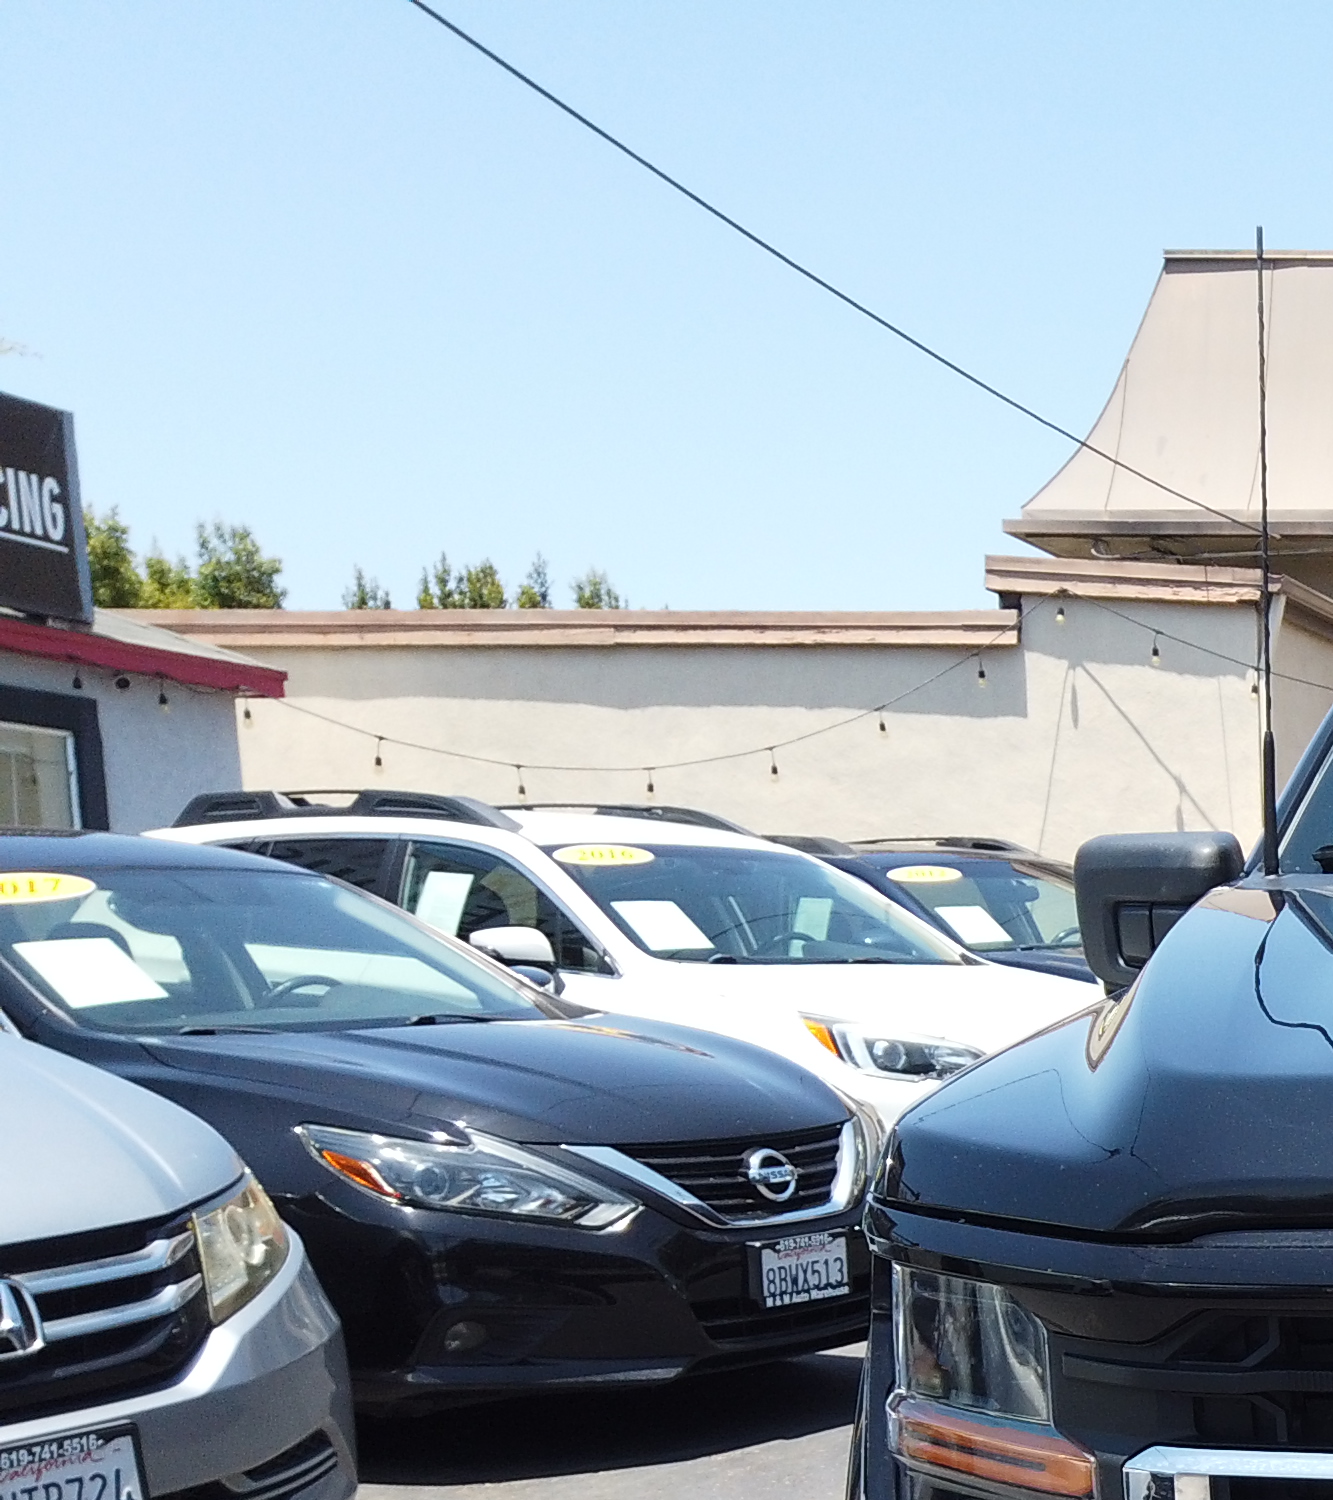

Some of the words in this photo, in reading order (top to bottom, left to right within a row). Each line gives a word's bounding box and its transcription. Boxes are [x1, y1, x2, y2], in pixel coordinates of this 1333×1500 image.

[577, 848, 634, 861] 2016
[765, 1256, 845, 1297] 8BWX513
[0, 1433, 98, 1470] 619-741-5516
